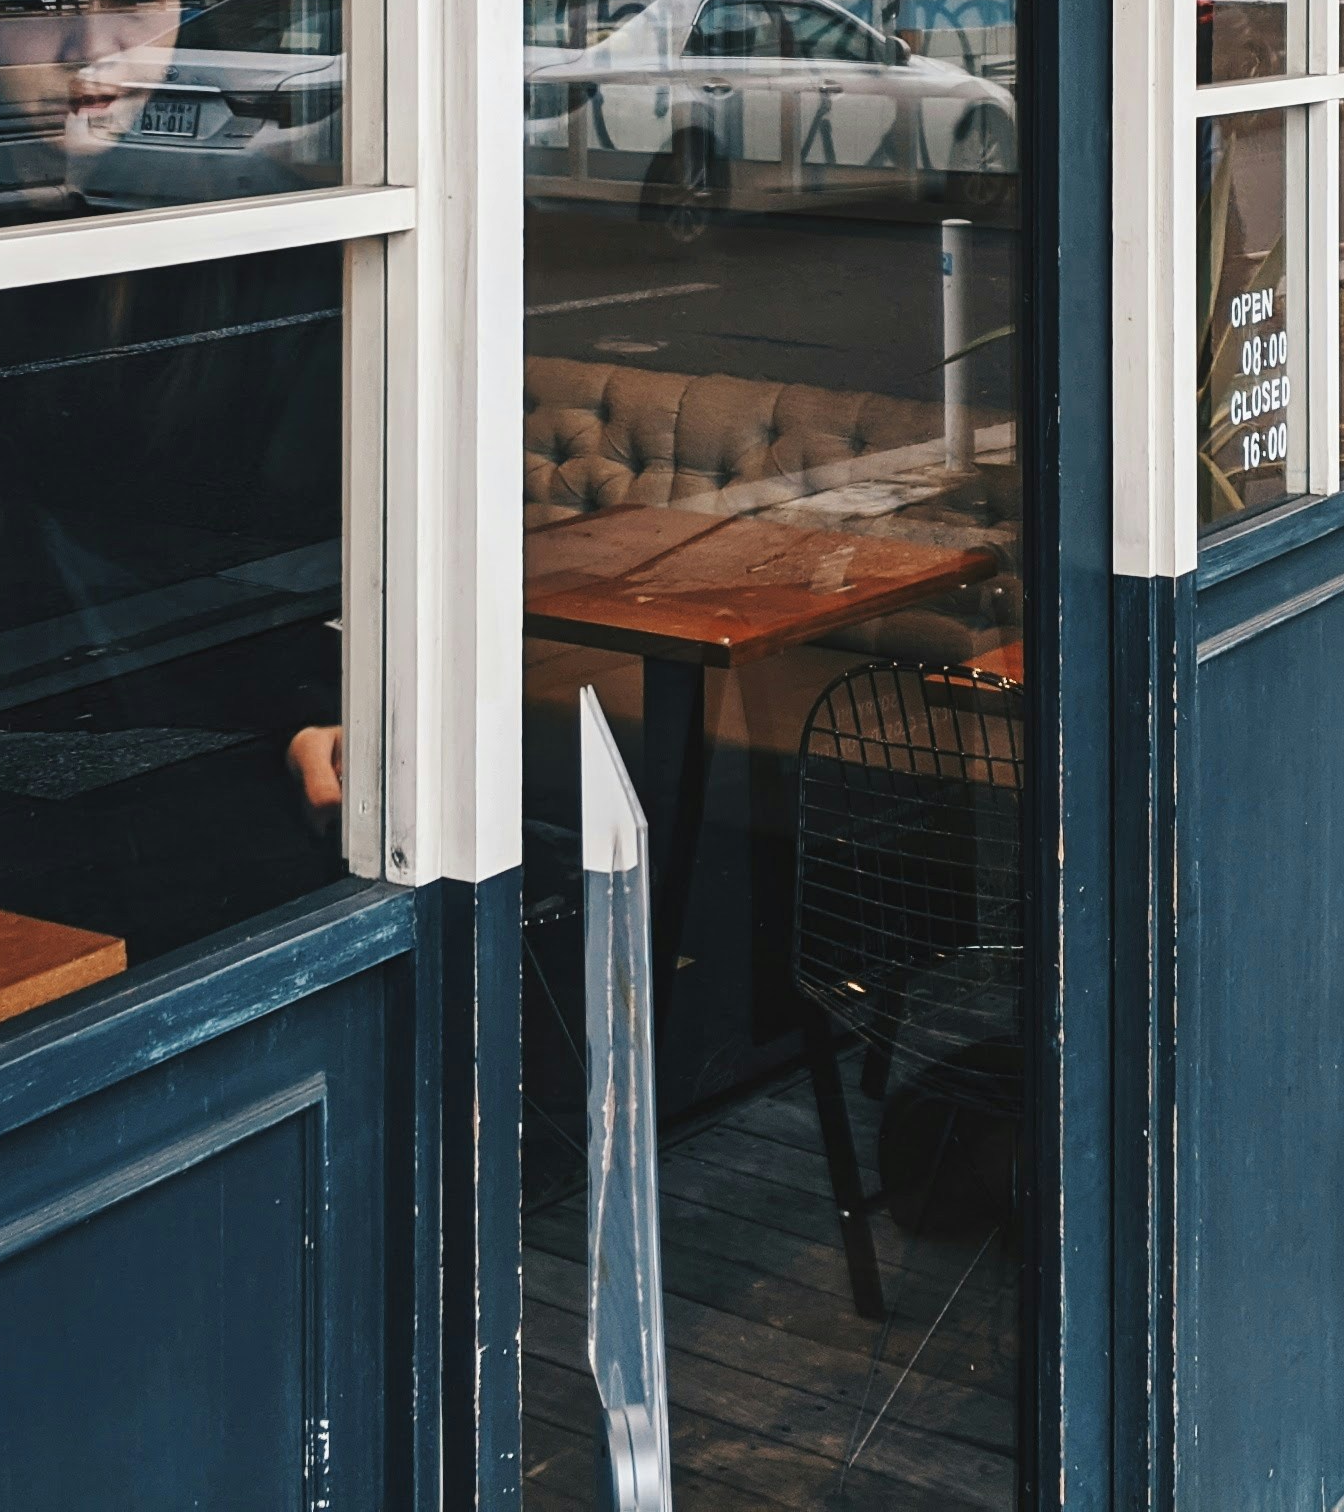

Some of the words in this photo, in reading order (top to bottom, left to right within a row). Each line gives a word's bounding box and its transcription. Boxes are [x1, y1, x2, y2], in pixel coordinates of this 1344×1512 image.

[1231, 288, 1273, 328] OPEN
[1242, 331, 1287, 376] 08:00
[1230, 375, 1291, 425] CLOSED
[1243, 422, 1287, 471] 16:00
